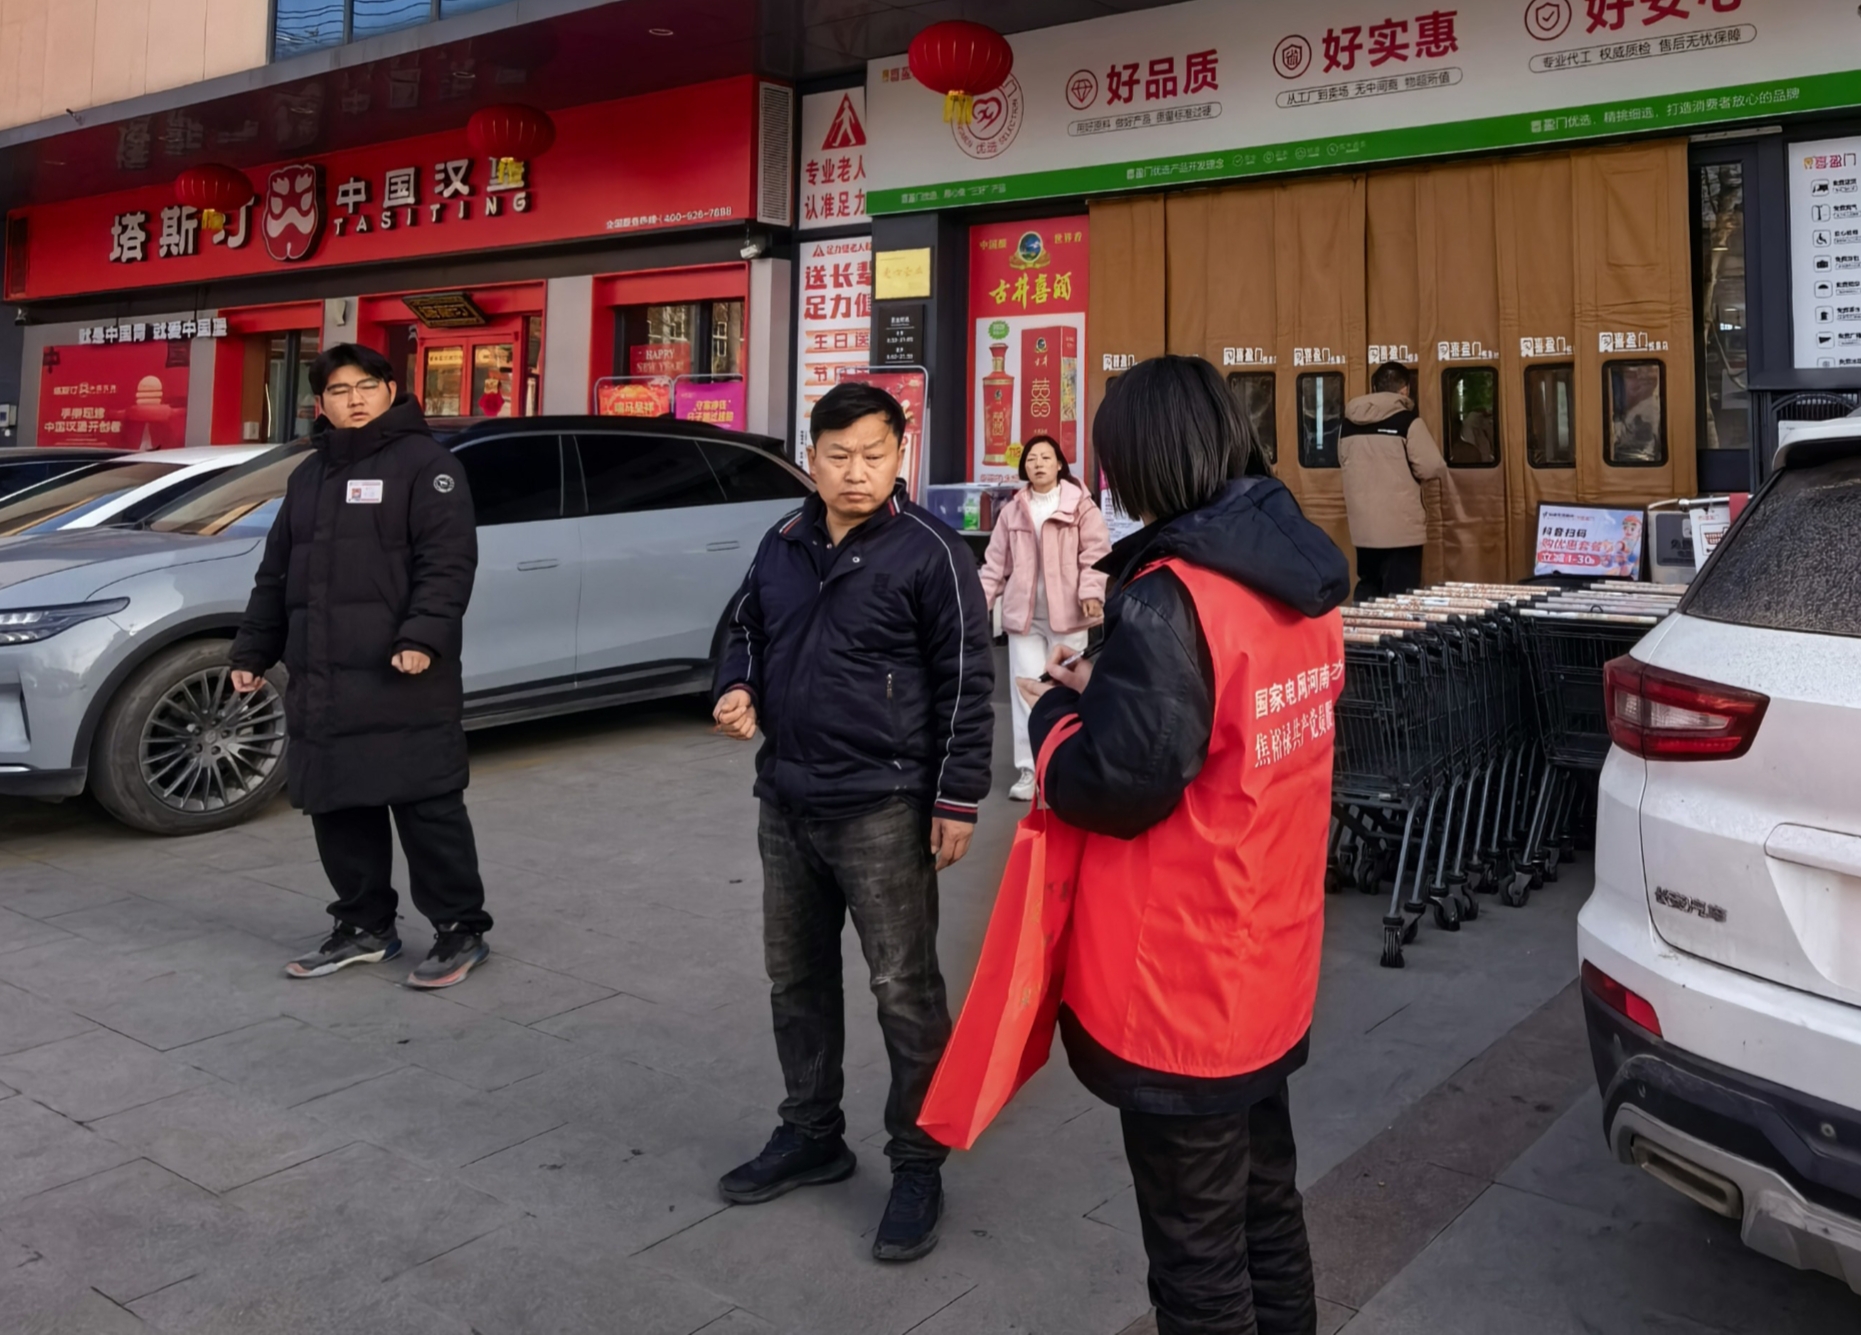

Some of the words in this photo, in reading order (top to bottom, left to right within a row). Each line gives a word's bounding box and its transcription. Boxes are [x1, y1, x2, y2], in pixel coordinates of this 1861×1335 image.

[1322, 10, 1459, 73] 好实惠
[1543, 50, 1592, 68] 专业代工
[1600, 41, 1651, 60] 权威质检
[1659, 28, 1742, 52] 售后无忧保障
[1106, 48, 1219, 106] 好品质
[806, 154, 866, 186] 专业老人
[334, 191, 527, 236] TASITING
[804, 188, 866, 220] 认准足力
[989, 271, 1072, 310] 古井喜酒
[646, 349, 674, 361] HAPPY
